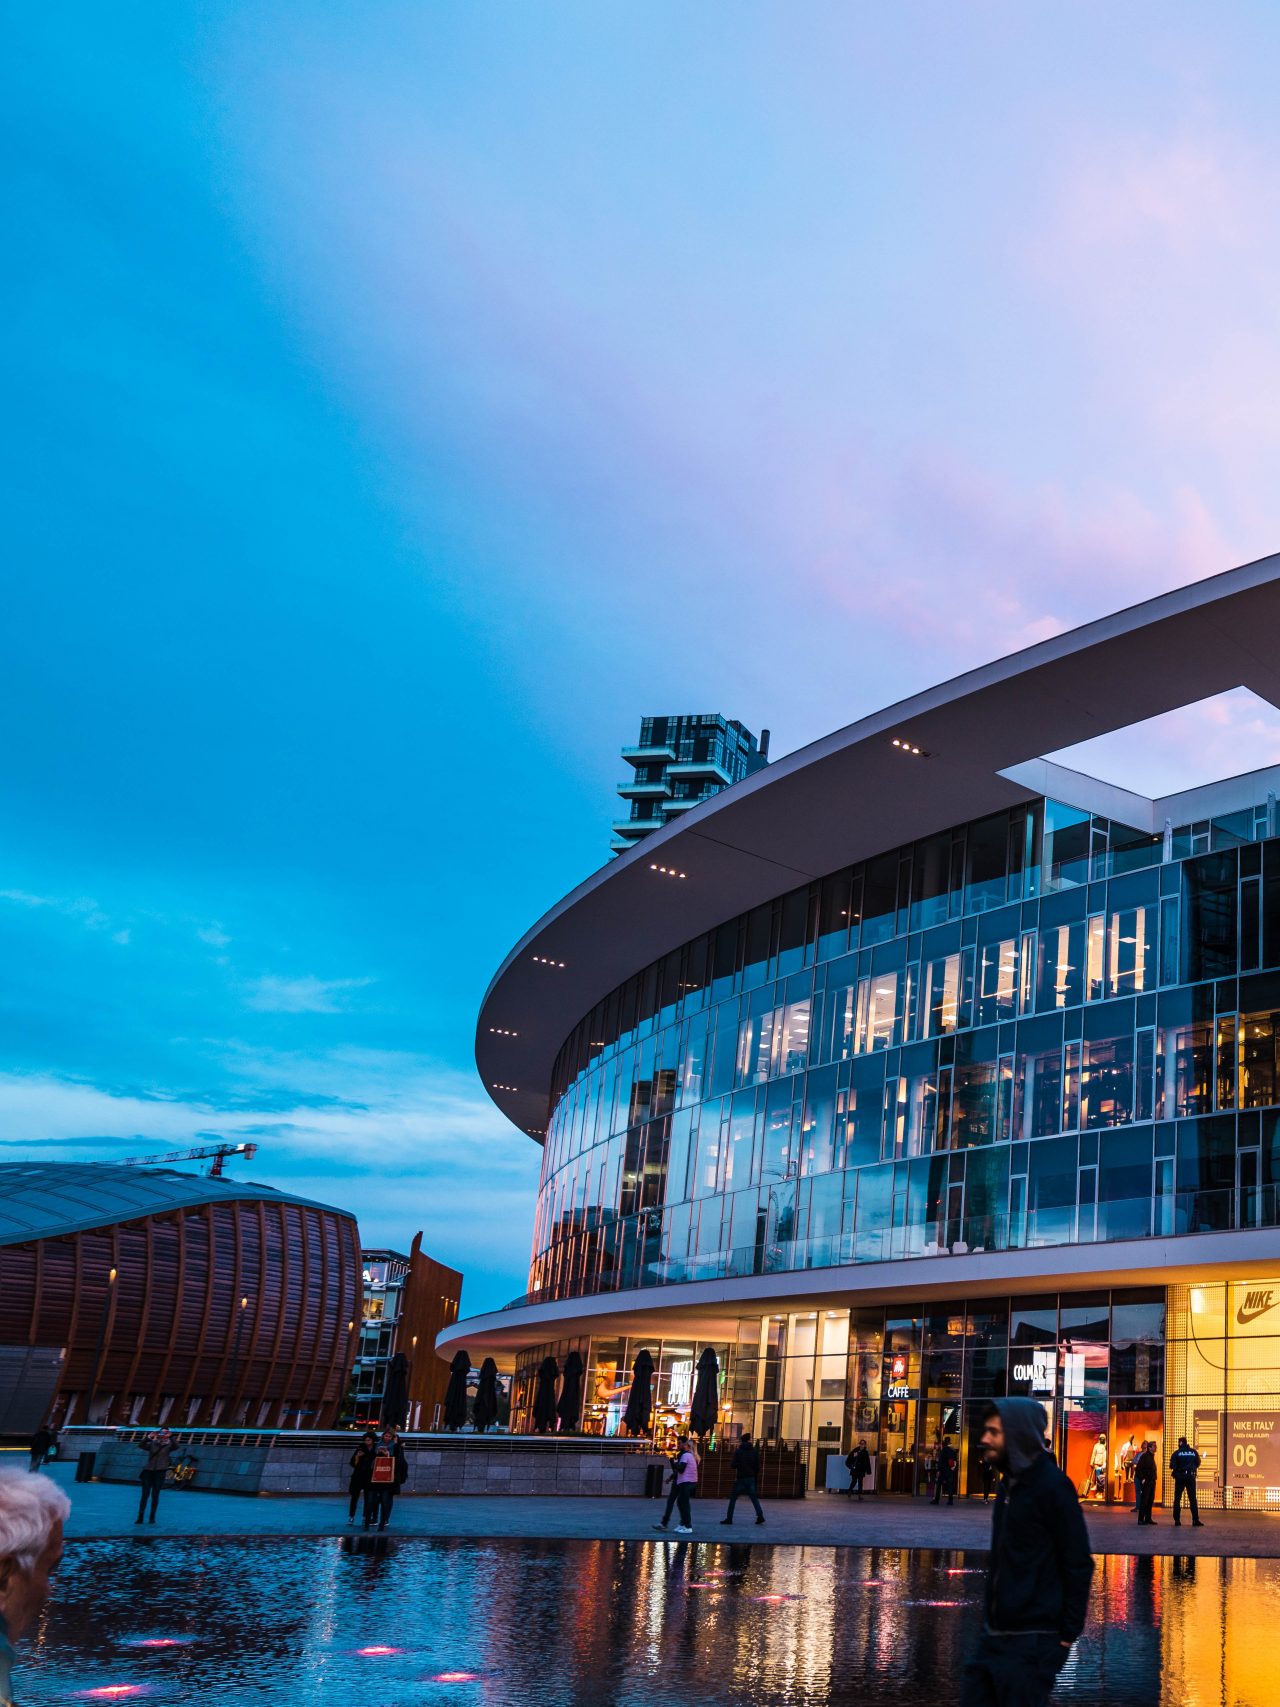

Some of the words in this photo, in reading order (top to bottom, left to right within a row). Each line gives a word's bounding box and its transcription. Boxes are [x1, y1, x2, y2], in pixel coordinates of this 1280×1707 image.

[1243, 1290, 1274, 1309] NIKE
[1013, 1364, 1046, 1381] COLMAR
[887, 1385, 909, 1398] CAFFÈ
[1233, 1421, 1252, 1431] NIKE
[1253, 1421, 1274, 1431] ITALY
[1233, 1444, 1257, 1467] 06
